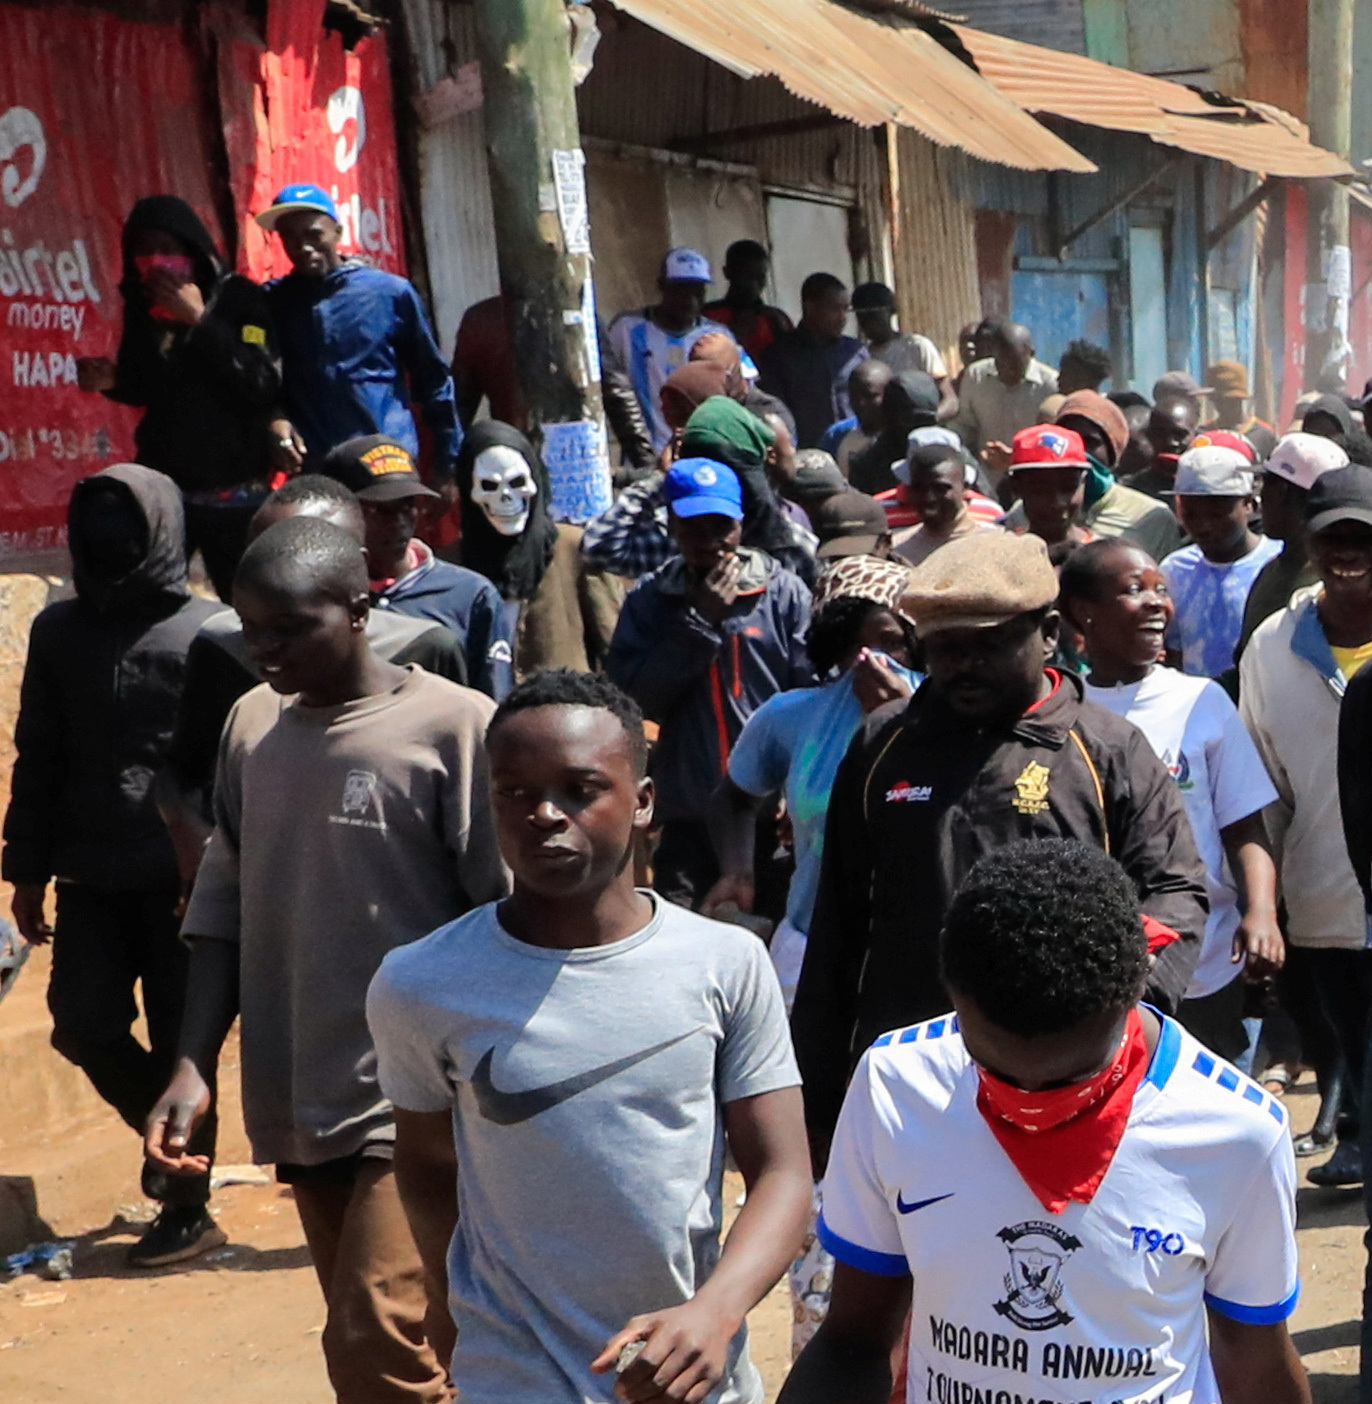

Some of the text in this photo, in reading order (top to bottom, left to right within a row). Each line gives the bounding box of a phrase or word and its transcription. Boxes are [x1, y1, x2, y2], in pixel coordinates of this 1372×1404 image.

[7, 302, 85, 341] money
[13, 350, 79, 388] HAPA
[1131, 1226, 1185, 1255] T90
[929, 1315, 1029, 1373] MADARA
[1042, 1343, 1158, 1379] ANNUAL
